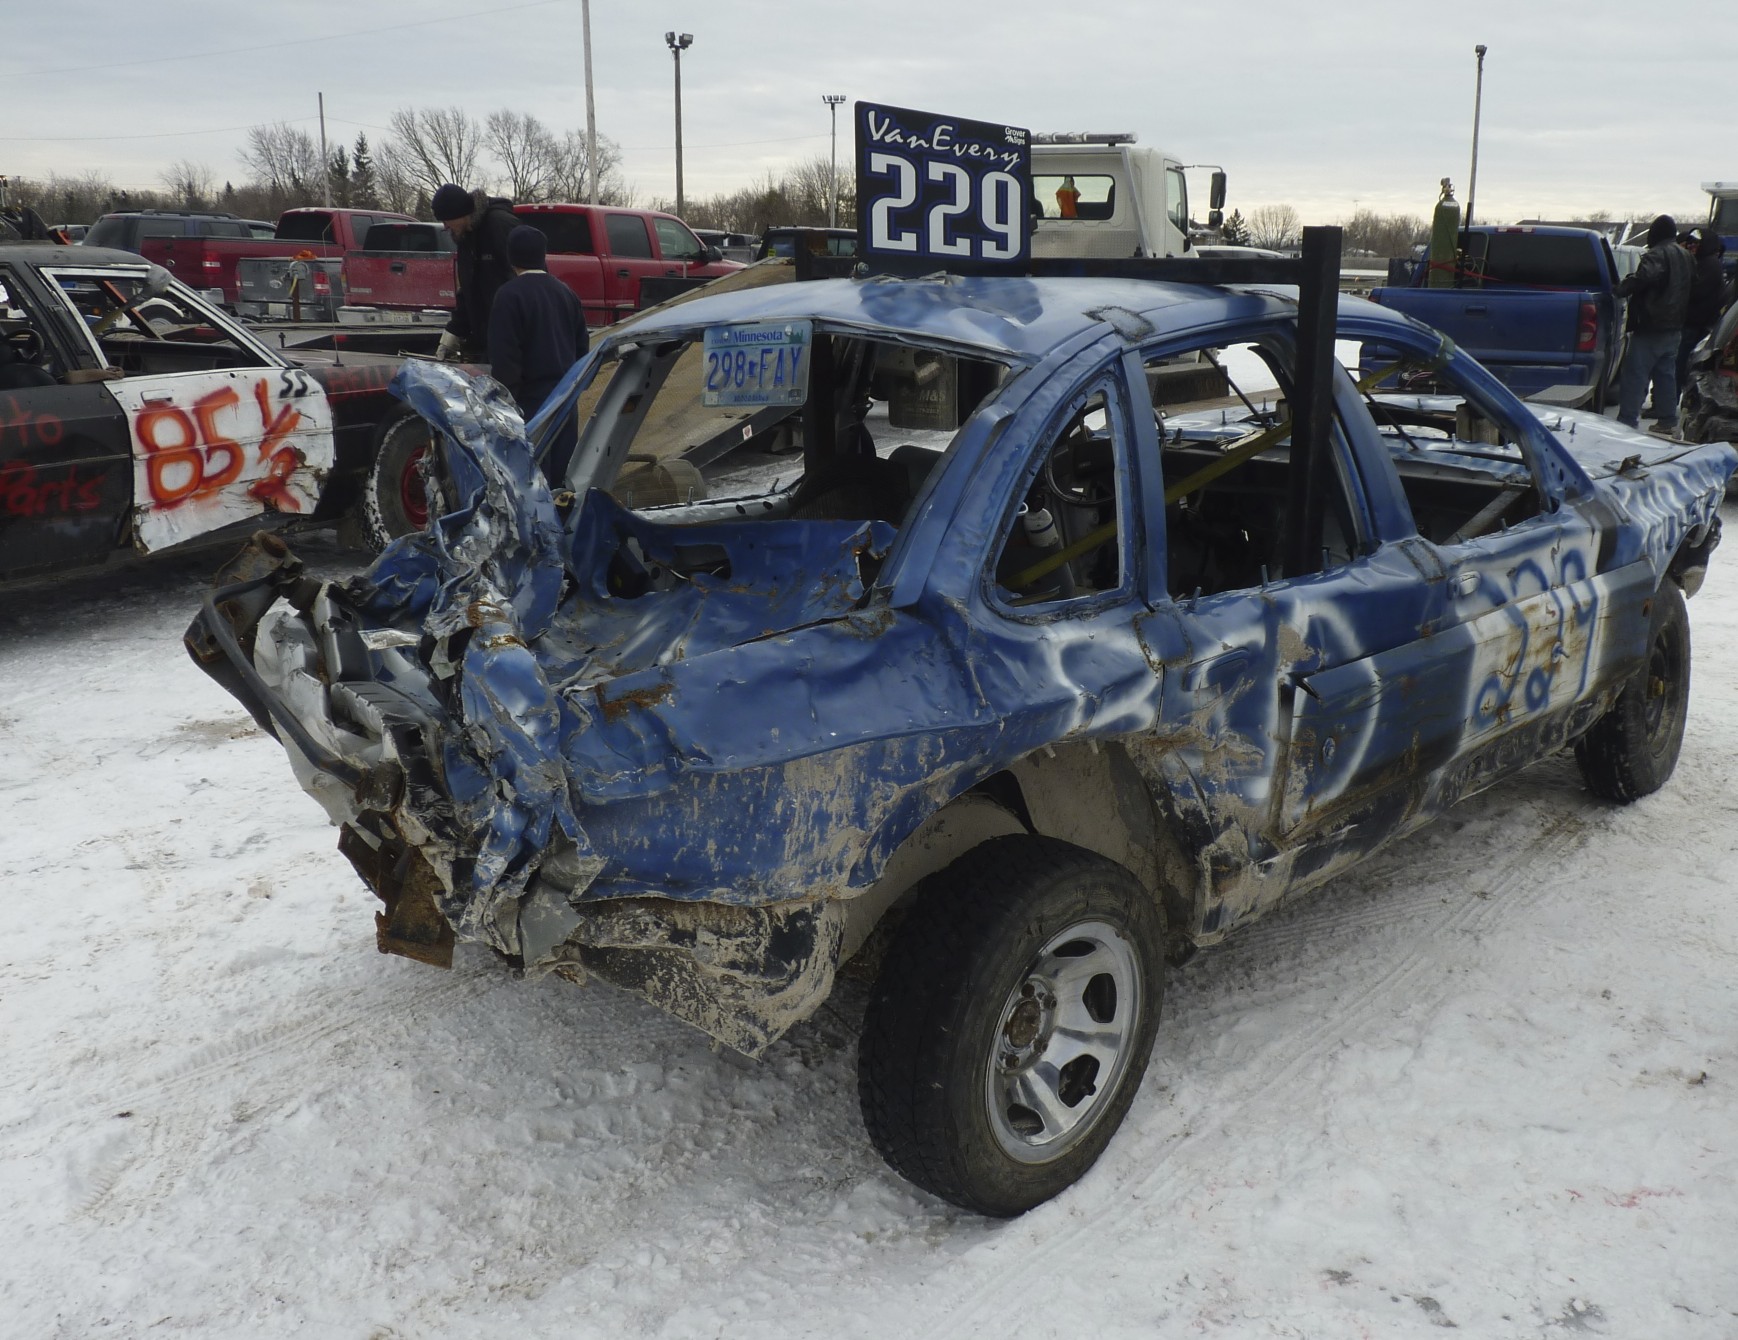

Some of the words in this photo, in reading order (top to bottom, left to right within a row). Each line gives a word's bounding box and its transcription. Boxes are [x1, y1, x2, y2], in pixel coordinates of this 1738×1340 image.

[1004, 126, 1026, 138] Grover
[870, 151, 1022, 260] 229
[733, 330, 783, 344] Minnesota
